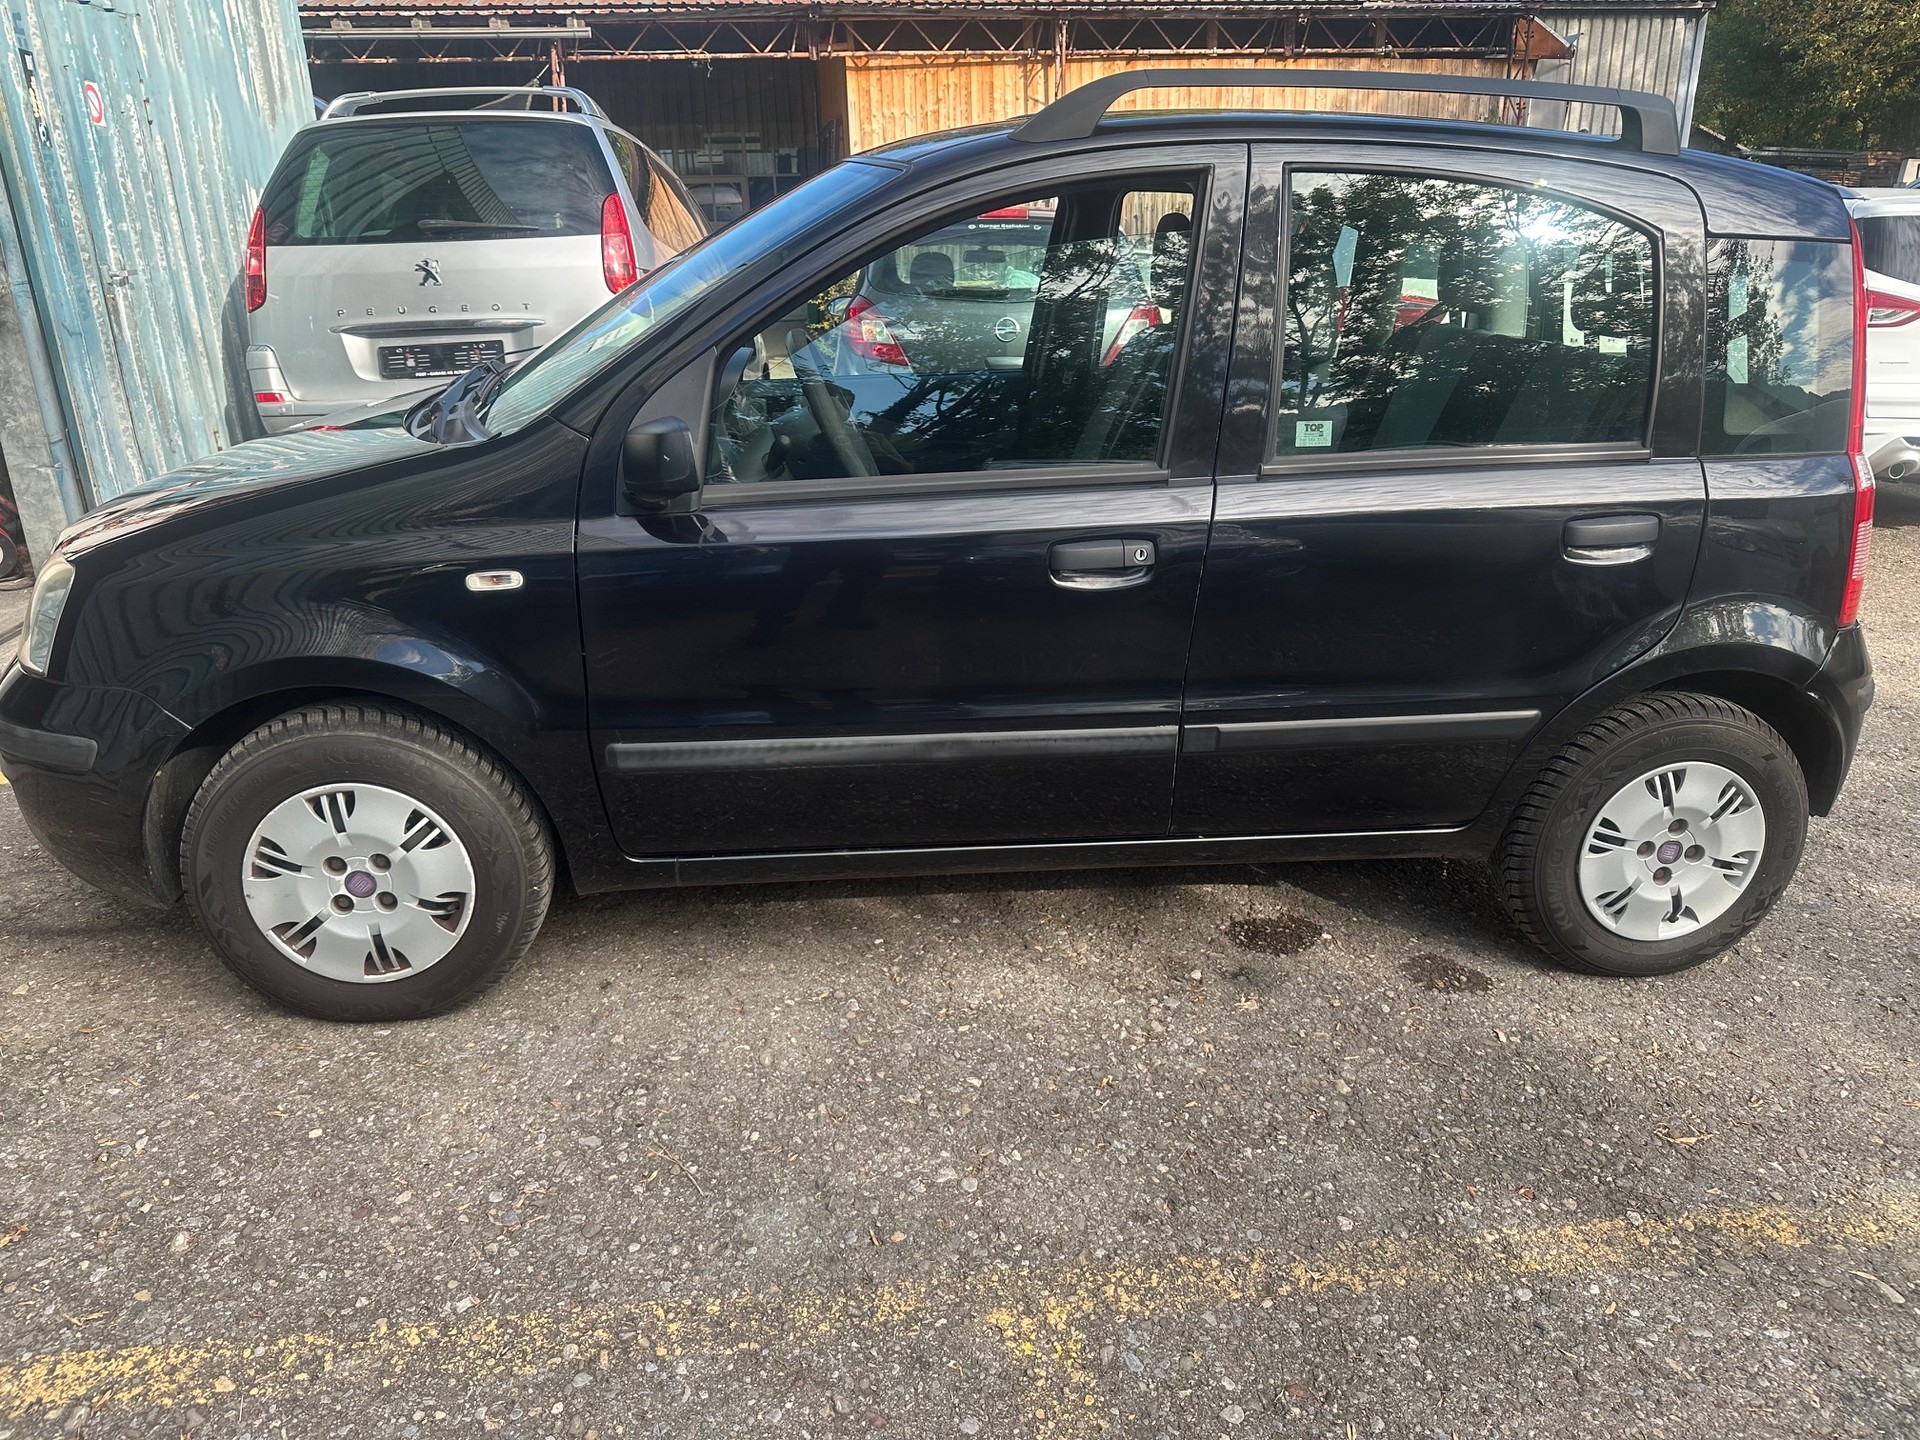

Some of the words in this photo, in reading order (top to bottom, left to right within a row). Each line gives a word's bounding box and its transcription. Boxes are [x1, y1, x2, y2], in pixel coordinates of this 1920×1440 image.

[337, 302, 531, 317] PEUGEOT
[1304, 423, 1325, 432] TOP
[351, 874, 372, 894] FIAT
